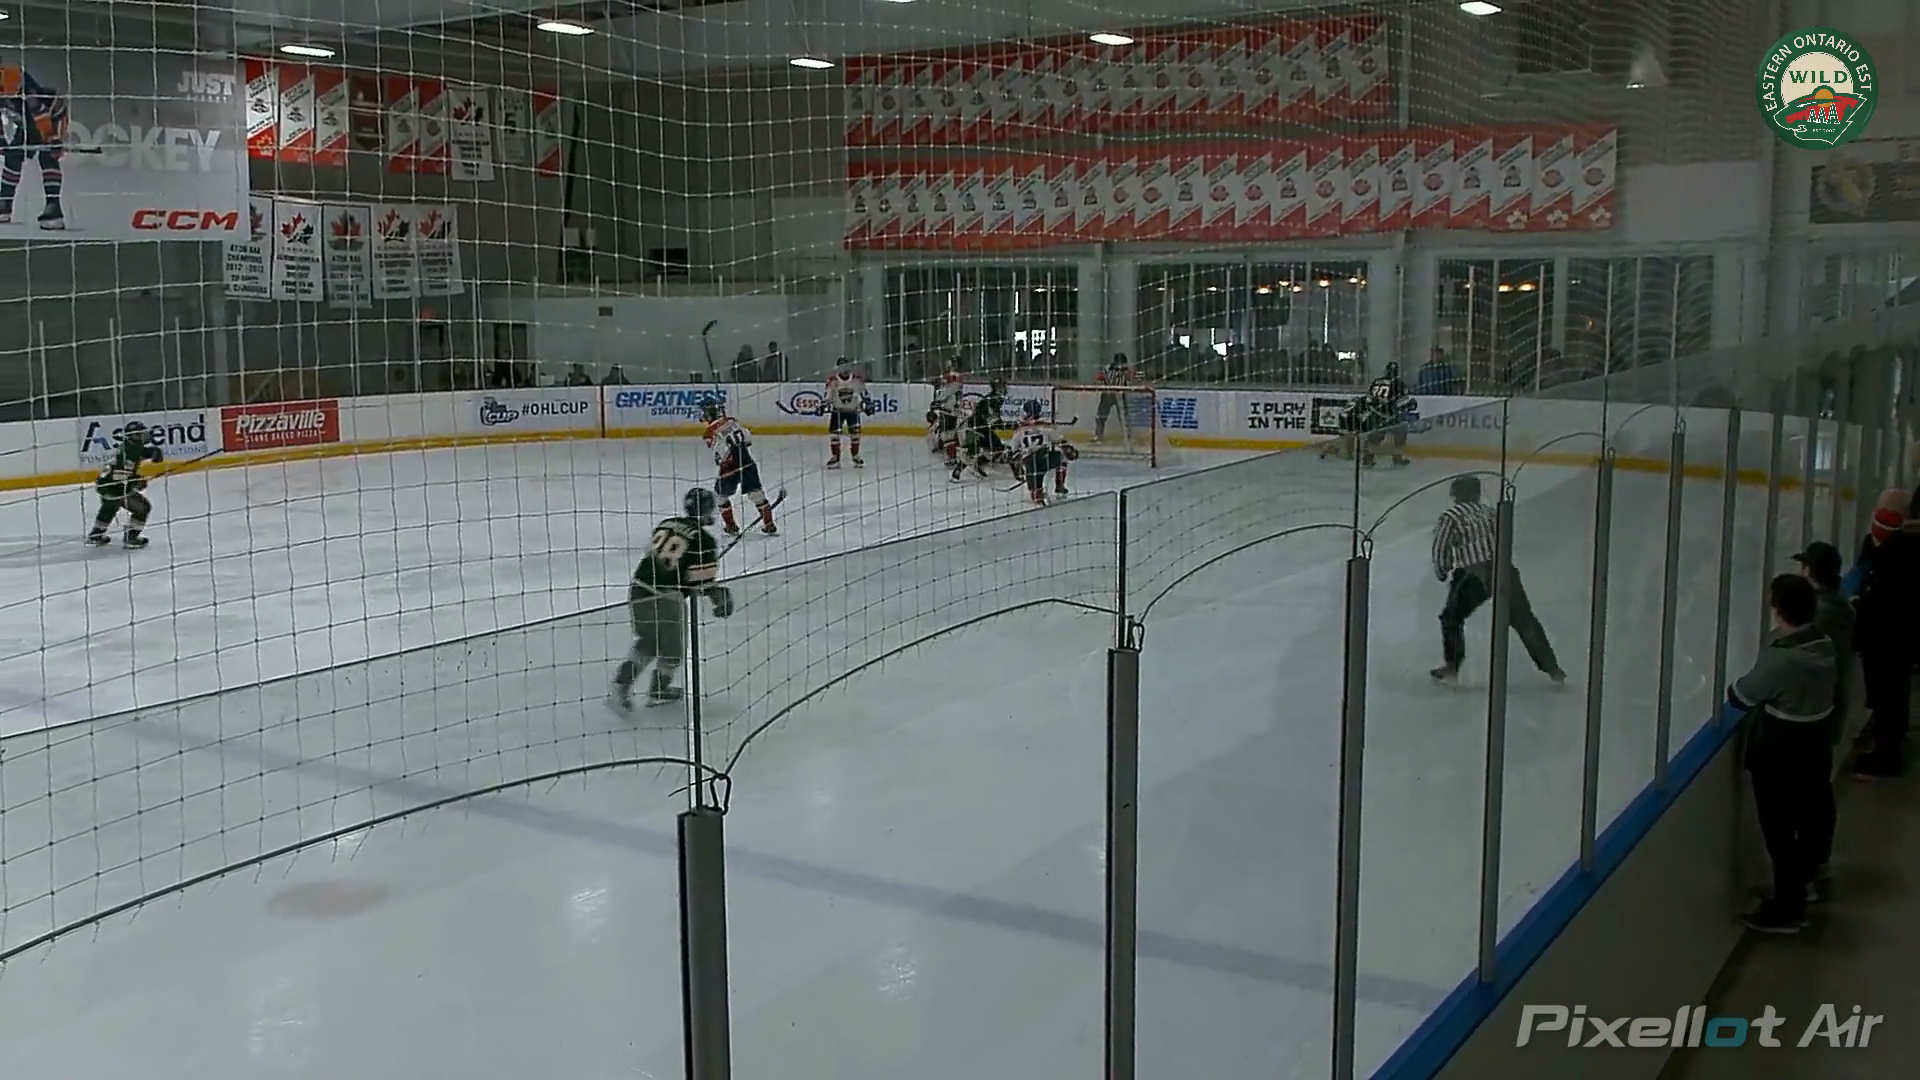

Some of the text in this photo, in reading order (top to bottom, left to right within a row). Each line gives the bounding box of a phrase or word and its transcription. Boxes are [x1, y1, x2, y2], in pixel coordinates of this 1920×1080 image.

[177, 71, 236, 96] JUST
[66, 121, 221, 171] OCKEY
[131, 210, 238, 230] CCM
[521, 402, 589, 415] #OHLCUP
[1250, 402, 1262, 415] I
[235, 409, 326, 434] Pizzaville
[1248, 417, 1305, 429] IN THE
[80, 414, 205, 452] Asend
